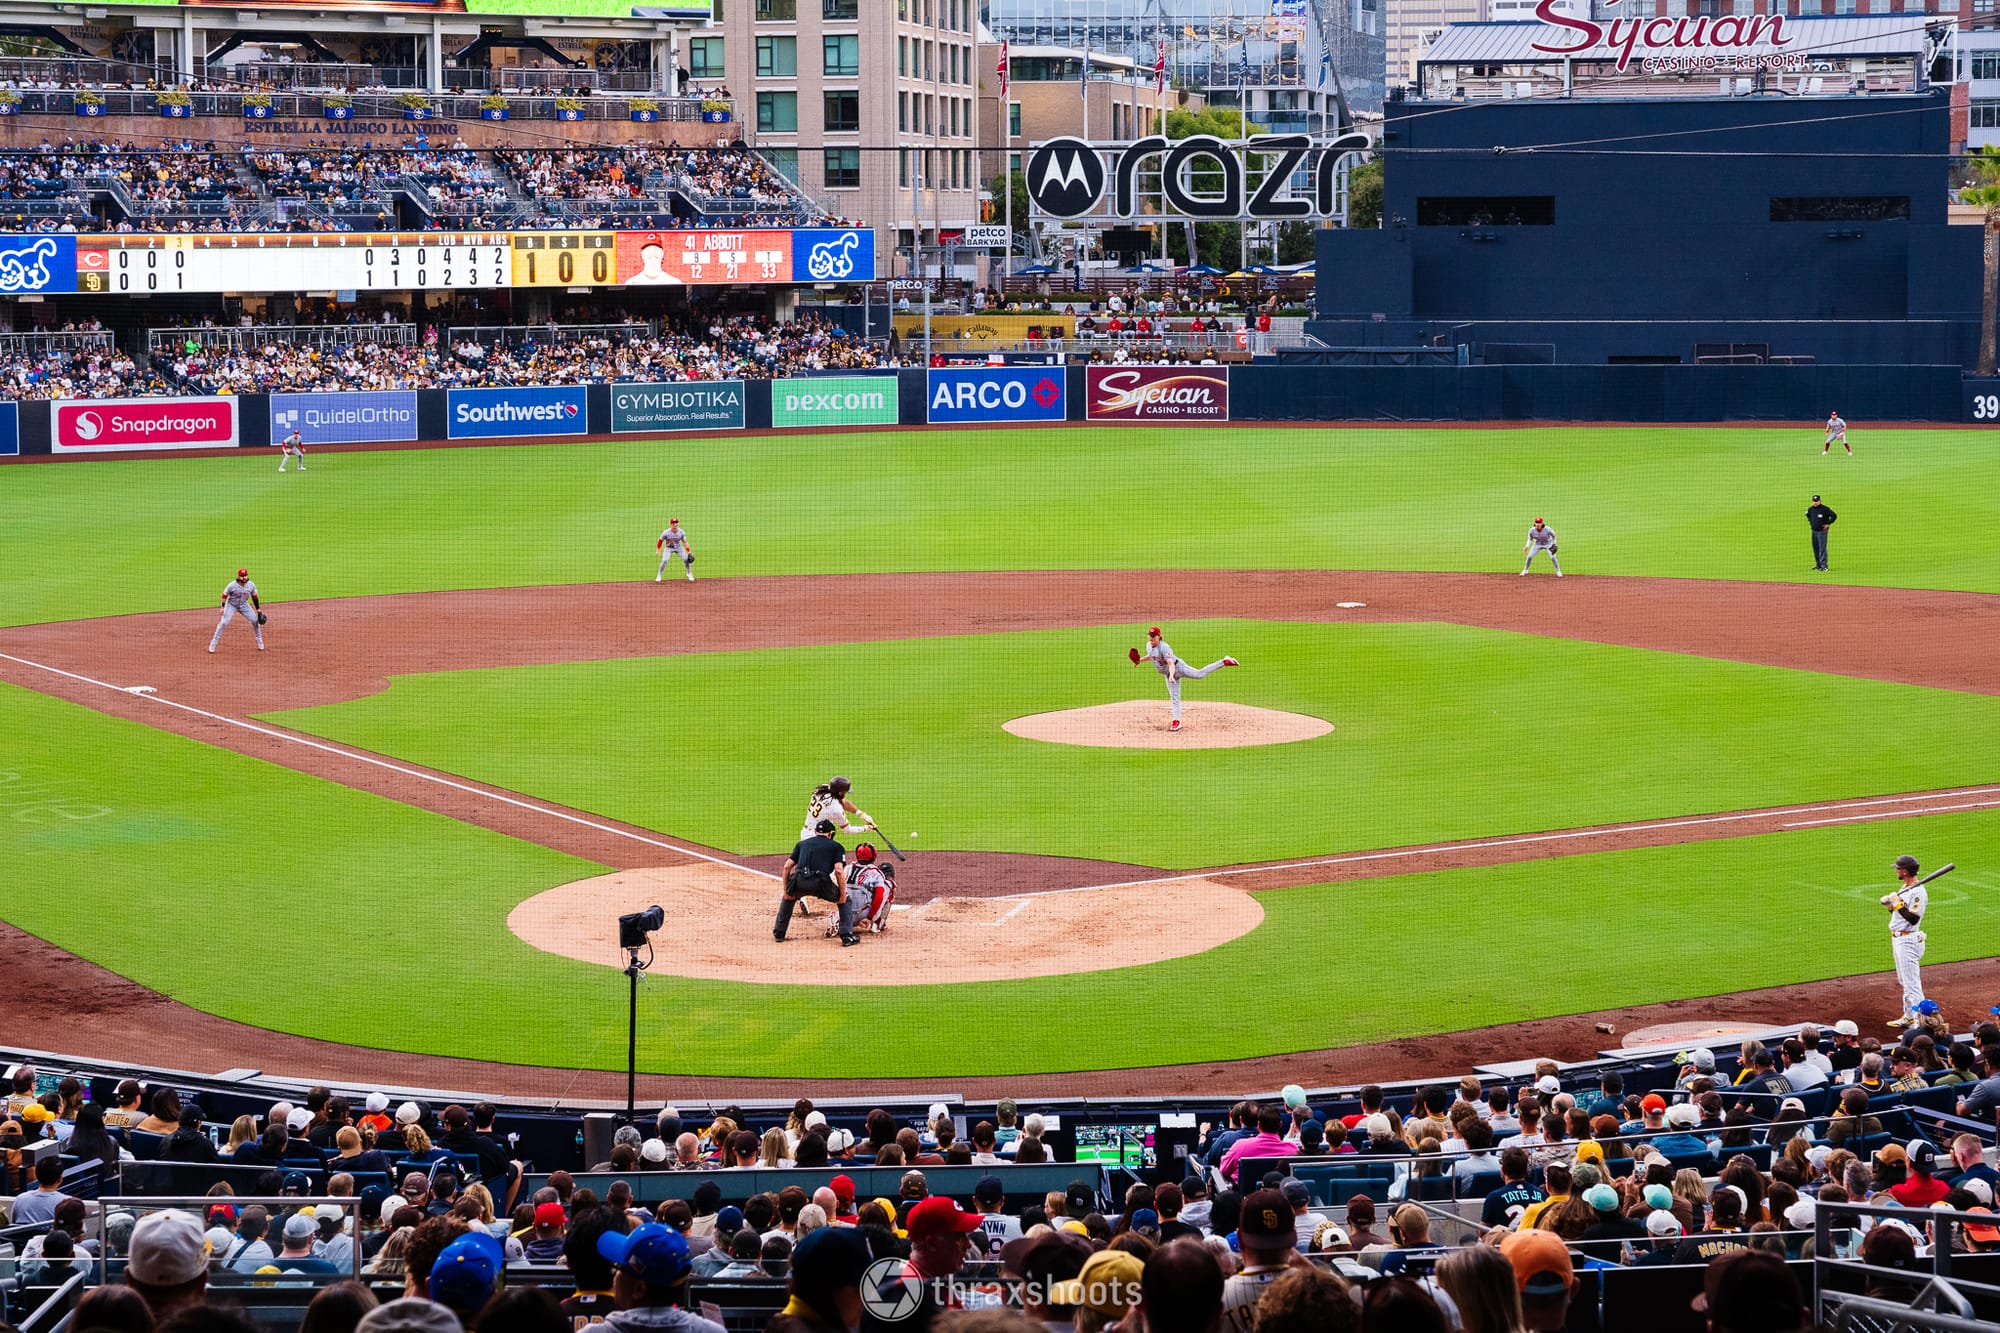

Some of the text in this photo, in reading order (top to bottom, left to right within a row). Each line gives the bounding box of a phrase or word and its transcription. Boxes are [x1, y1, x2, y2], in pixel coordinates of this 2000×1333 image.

[1530, 0, 1795, 73] Sycuan
[1643, 56, 1715, 71] CASINO
[1735, 53, 1807, 70] RESORT
[244, 121, 459, 135] ESTRELLA JALISCO LANDING
[1115, 133, 1372, 219] razr
[120, 234, 507, 248] 1 2 3 4 5 6 7 8 9 R H E LOB MVR ABS
[970, 226, 1006, 239] petco
[527, 237, 534, 248] B
[561, 236, 568, 248] S
[684, 233, 744, 250] 41 ABBOTT
[966, 238, 1009, 246] BARKYAR
[119, 250, 128, 268] 0
[147, 250, 157, 268] 0
[175, 250, 185, 268] 0
[365, 248, 374, 266] 0
[391, 248, 400, 266] 3
[417, 248, 426, 265] 0
[443, 248, 451, 265] 4
[469, 247, 477, 265] 4
[495, 247, 503, 264] 2
[730, 252, 736, 263] S
[766, 251, 772, 262] T
[526, 250, 608, 283] 1 0 0
[691, 264, 777, 279] 12 21 33
[119, 272, 129, 290] 0
[148, 272, 157, 290] 0
[177, 272, 183, 290] 1
[366, 269, 372, 287] 1
[393, 269, 399, 287] 1
[418, 269, 426, 286] 0
[443, 268, 452, 286] 2
[469, 268, 478, 285] 3
[495, 268, 503, 285] 2
[616, 391, 739, 410] CYMBIOTIKA
[931, 380, 1027, 409] ARCO
[1098, 370, 1215, 416] Sycuan
[305, 407, 410, 428] QuidelOrtho
[456, 400, 563, 424] Southwest
[626, 411, 654, 423] Superior
[654, 411, 690, 422] Absorption.
[690, 411, 705, 420] Real
[1146, 405, 1219, 415] CASINO RESORT
[111, 414, 217, 436] Snapdragon
[105, 1112, 131, 1127] MILLER
[1500, 1189, 1543, 1204] TATIS JR
